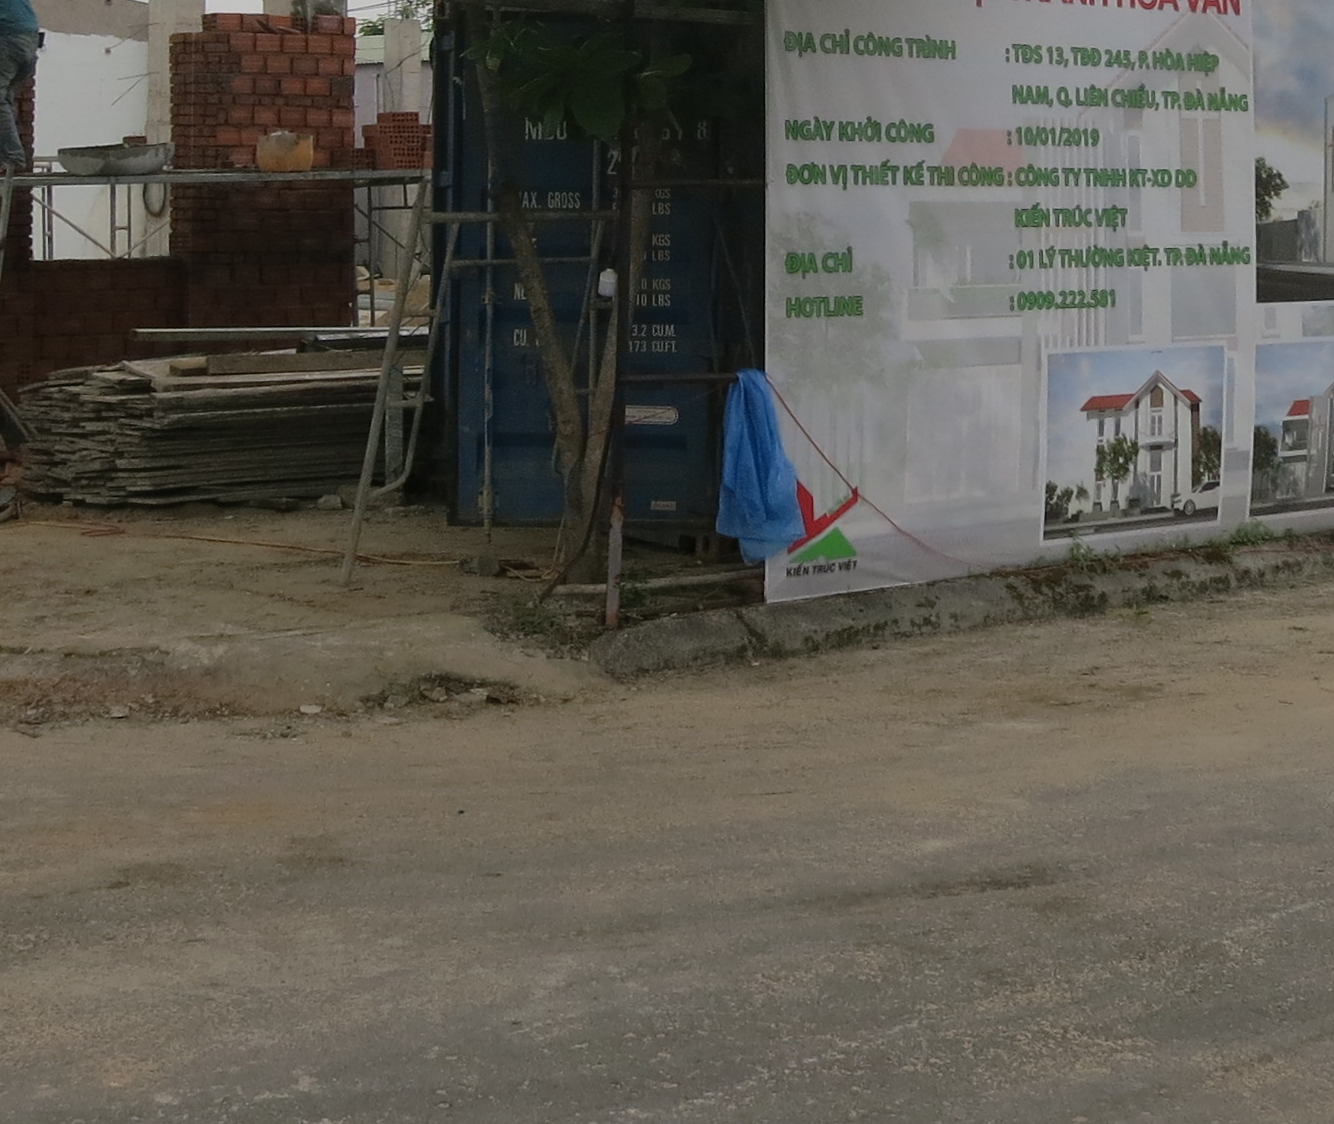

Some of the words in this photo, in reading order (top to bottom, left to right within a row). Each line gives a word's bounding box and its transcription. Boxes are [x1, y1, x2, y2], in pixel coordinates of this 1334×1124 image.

[783, 31, 816, 57] ĐỊA
[853, 31, 903, 57] CÔNG
[905, 34, 957, 60] TRÌNH
[1047, 46, 1069, 68] 13,
[1104, 49, 1135, 71] 245,
[1152, 48, 1185, 71] HÒA
[1187, 50, 1220, 77] HIỆP
[1012, 84, 1053, 108] NAM,
[1075, 84, 1109, 107] LIÊN
[785, 116, 835, 141] NGÀY
[839, 116, 881, 142] KHỞI
[885, 119, 935, 143] CÔNG
[1015, 127, 1100, 148] 10/01/2019
[786, 162, 827, 185] ĐƠN
[829, 164, 848, 191] VỊ
[850, 159, 900, 186] THIẾT
[903, 160, 925, 186] KẾ
[927, 166, 955, 186] THI
[958, 162, 1005, 187] CÔNG
[1015, 163, 1060, 187] CÔNG
[1063, 168, 1082, 187] TY
[1083, 168, 1127, 187] TNHH
[547, 191, 581, 209] GROSS
[652, 202, 672, 215] LBS
[1014, 202, 1051, 228] KIẾN
[1052, 204, 1093, 227] TRÚC
[1094, 204, 1128, 232] VIỆT
[652, 234, 671, 247] KGS
[784, 252, 818, 280] ĐỊA
[1017, 249, 1034, 269] 01
[1038, 245, 1057, 269] LÝ
[1058, 244, 1125, 269] THƯỜNG
[652, 279, 671, 291] KGS
[652, 294, 671, 307] LBS
[785, 295, 864, 318] HOTLINE
[1016, 288, 1116, 311] 0909.222.581
